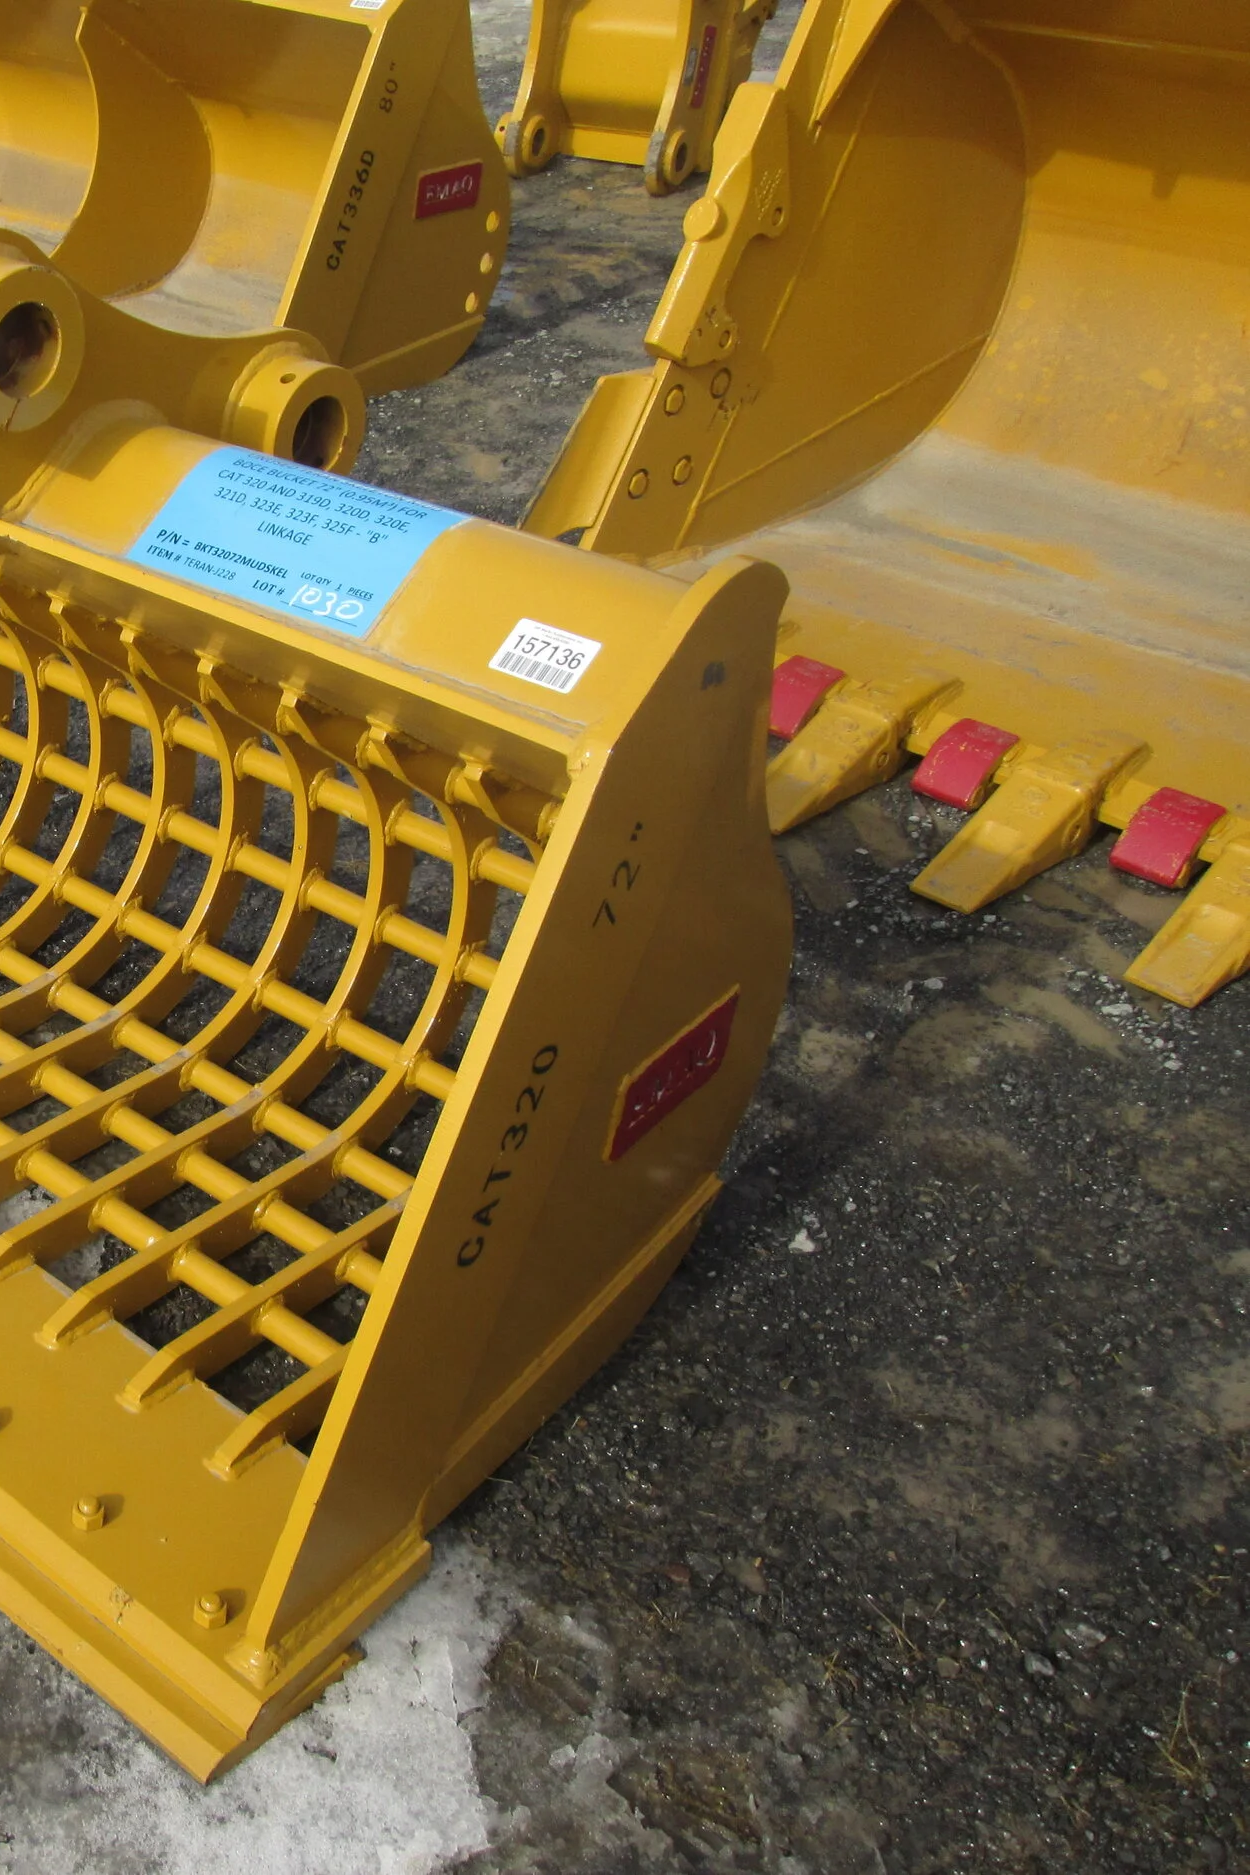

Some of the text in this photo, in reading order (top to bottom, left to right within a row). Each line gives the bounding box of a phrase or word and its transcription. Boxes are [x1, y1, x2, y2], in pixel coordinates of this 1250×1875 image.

[326, 150, 375, 271] CAT336D
[218, 469, 411, 534] CAT 320 AND 319D, 320D, 320E,
[232, 458, 268, 473] BOCE
[266, 468, 315, 487] BUCKET
[316, 482, 342, 493] 72"
[397, 506, 428, 520] FOR
[213, 486, 247, 506] 321D,
[249, 496, 284, 518] 323E,
[285, 507, 320, 528] 323F,
[321, 518, 356, 536] 325F
[366, 529, 390, 544] "B"
[257, 520, 313, 546] LINKAGE
[146, 544, 174, 561] ITEM
[183, 556, 237, 581] TERAN-J228
[156, 529, 182, 545] P/N
[193, 541, 289, 579] BKT32072MUDSKEL
[252, 579, 277, 594] LOT
[288, 583, 364, 620] 1030
[347, 586, 375, 601] PIECES
[513, 634, 585, 670] 157136
[456, 1044, 559, 1269] CAT320
